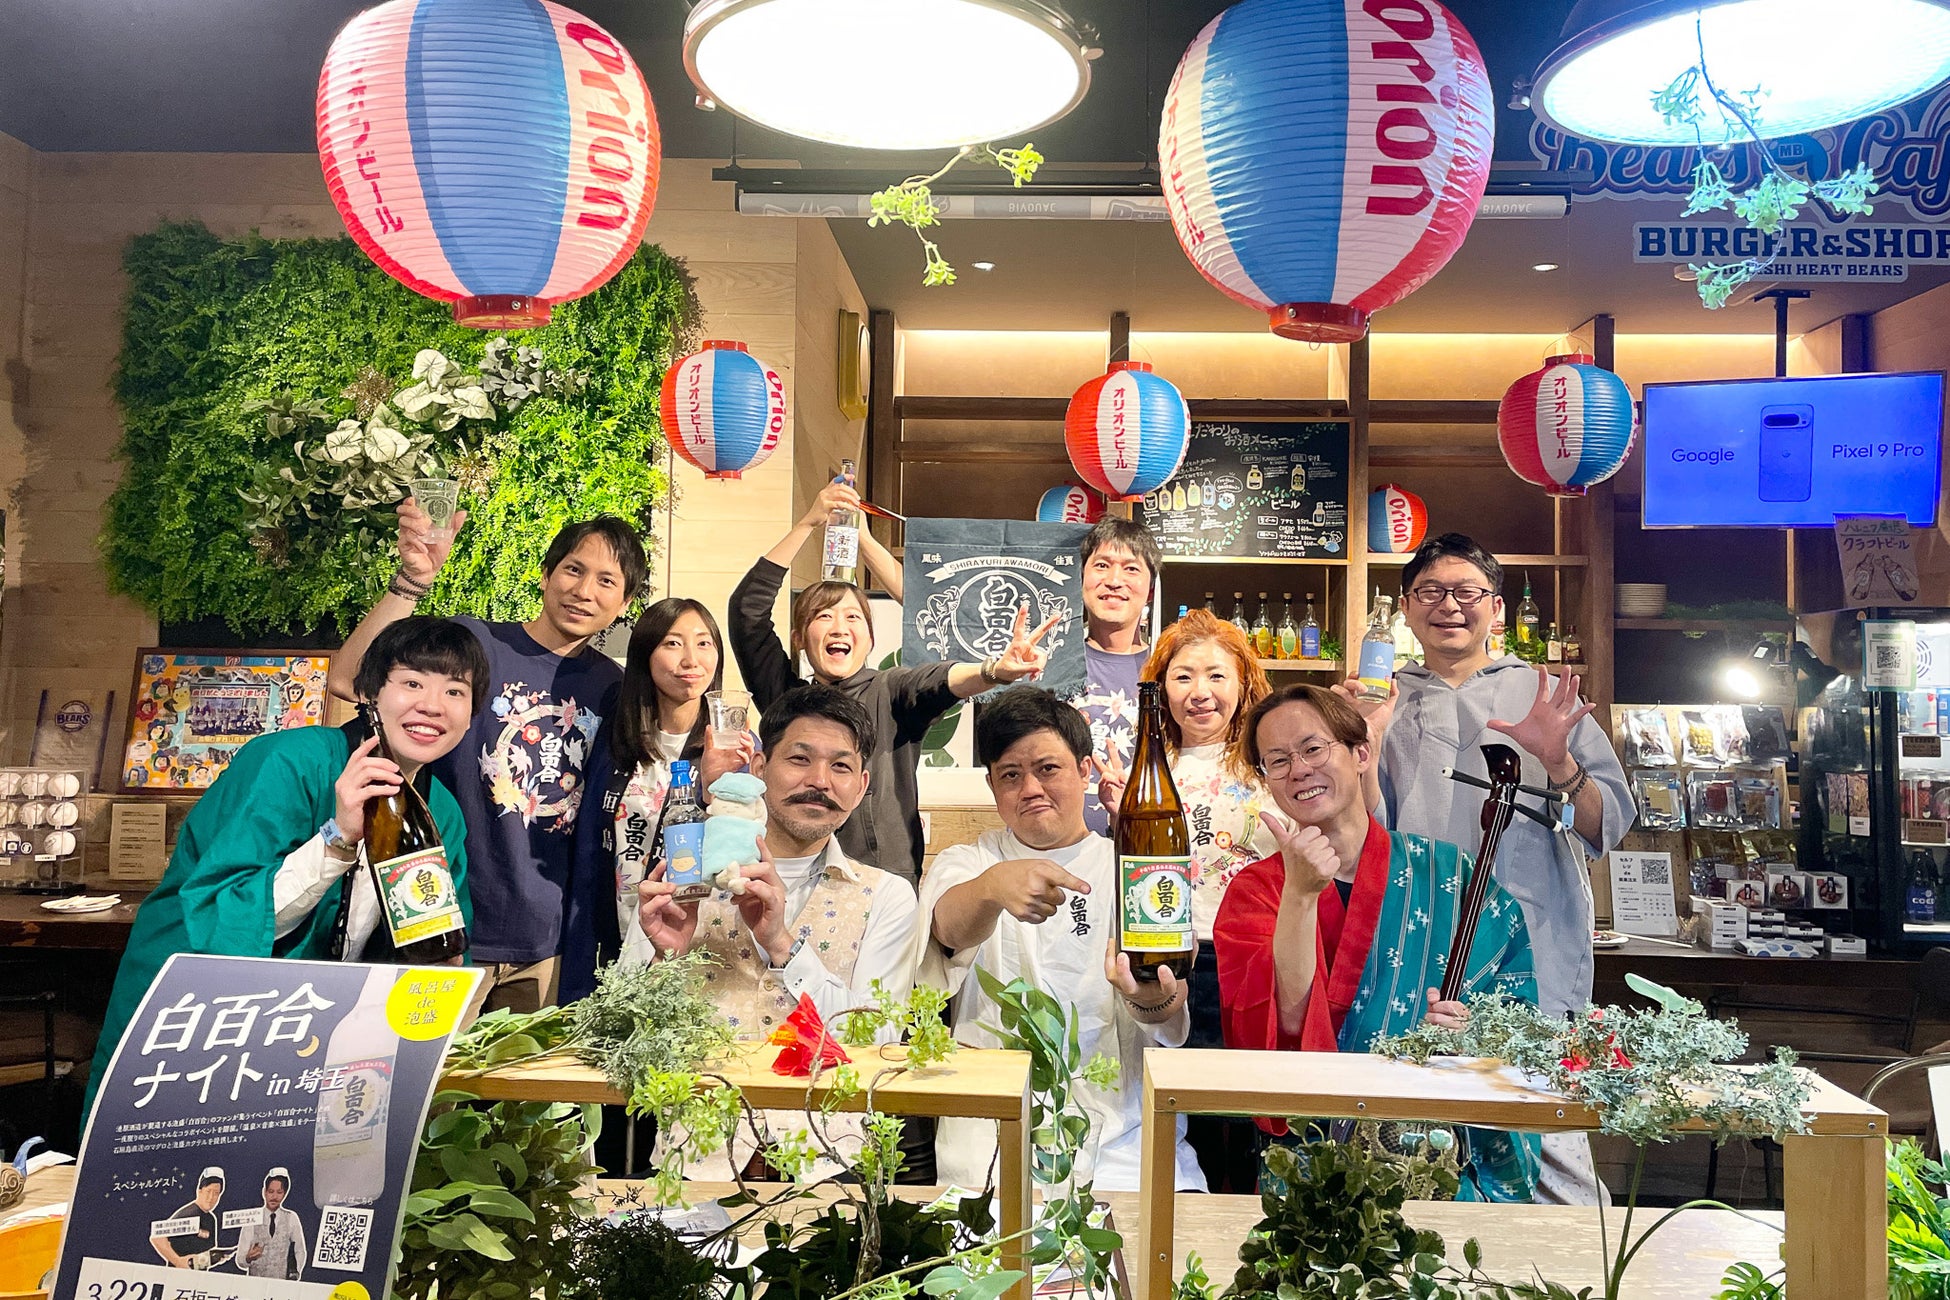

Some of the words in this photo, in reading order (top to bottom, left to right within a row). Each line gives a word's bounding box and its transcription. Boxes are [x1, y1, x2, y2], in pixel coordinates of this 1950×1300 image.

[1779, 144, 1803, 158] MB
[1796, 264, 1843, 275] HEAT
[1847, 264, 1903, 276] BEARS
[689, 363, 706, 445] オリオンビール
[1554, 376, 1571, 459] オリオンビール
[1112, 387, 1128, 469] オリオンビール
[1671, 448, 1735, 465] Google
[1832, 444, 1873, 458] Pixel
[1877, 444, 1888, 458] 9
[1893, 443, 1924, 457] Pro
[1271, 500, 1300, 510] ビール
[1843, 537, 1910, 551] クラフトビール
[950, 558, 1001, 571] SHIRAYURI
[1003, 559, 1049, 573] AWAMORI
[974, 577, 1018, 654] 白百合
[57, 713, 91, 726] BEARS
[538, 732, 564, 784] 白百合
[618, 812, 648, 862] 白百合
[1191, 803, 1215, 847] 白百合
[674, 834, 688, 846] ほ
[415, 869, 439, 907] 白百合
[1155, 875, 1176, 918] 白百合
[1069, 895, 1091, 937] 白百合
[408, 979, 456, 994] 風呂屋
[417, 997, 436, 1008] de
[141, 982, 336, 1056] 白百合
[404, 1010, 438, 1026] 泡盛
[133, 1052, 264, 1109] ナイト
[266, 1073, 291, 1096] in
[294, 1065, 349, 1094] 埼玉
[340, 1075, 367, 1126] 白百合
[113, 1176, 178, 1191] スペシャルゲスト
